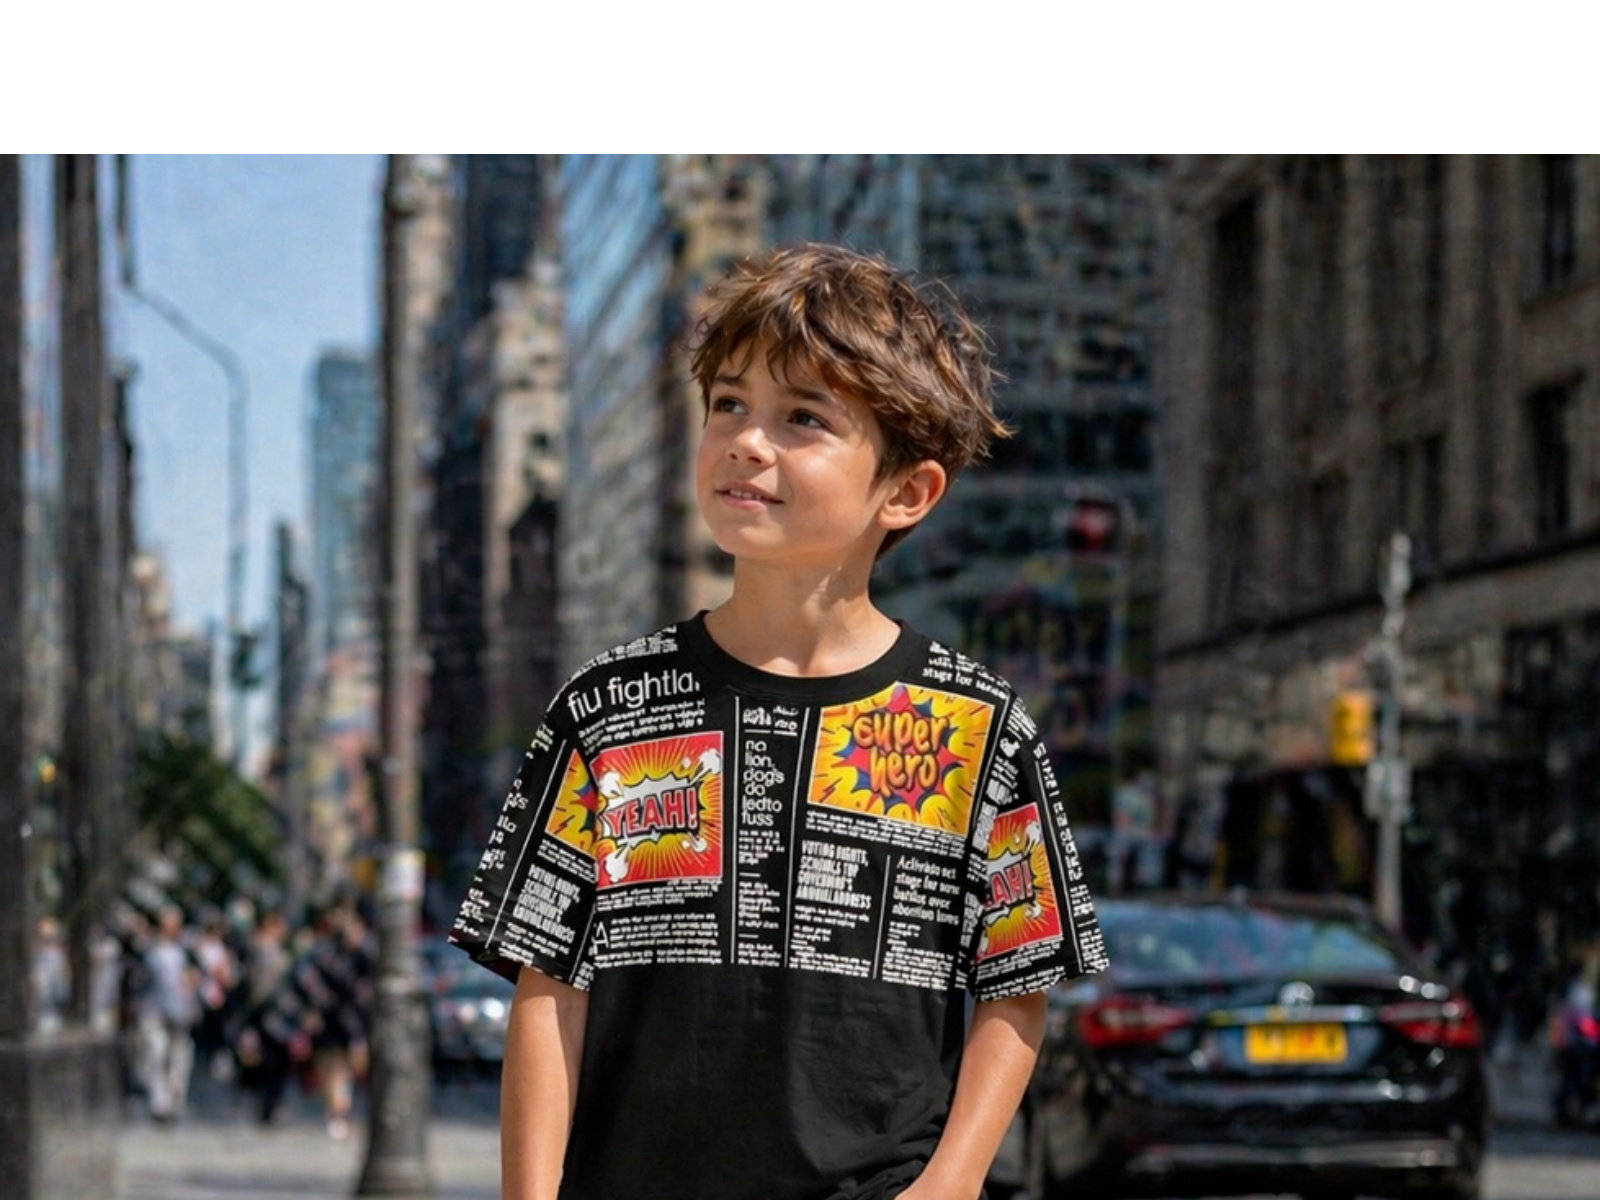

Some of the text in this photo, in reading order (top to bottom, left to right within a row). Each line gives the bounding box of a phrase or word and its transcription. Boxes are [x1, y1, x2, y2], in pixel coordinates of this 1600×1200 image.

[853, 710, 949, 754] super
[869, 746, 938, 797] hero
[603, 787, 698, 837] YEAH!
[742, 809, 774, 826] fuss
